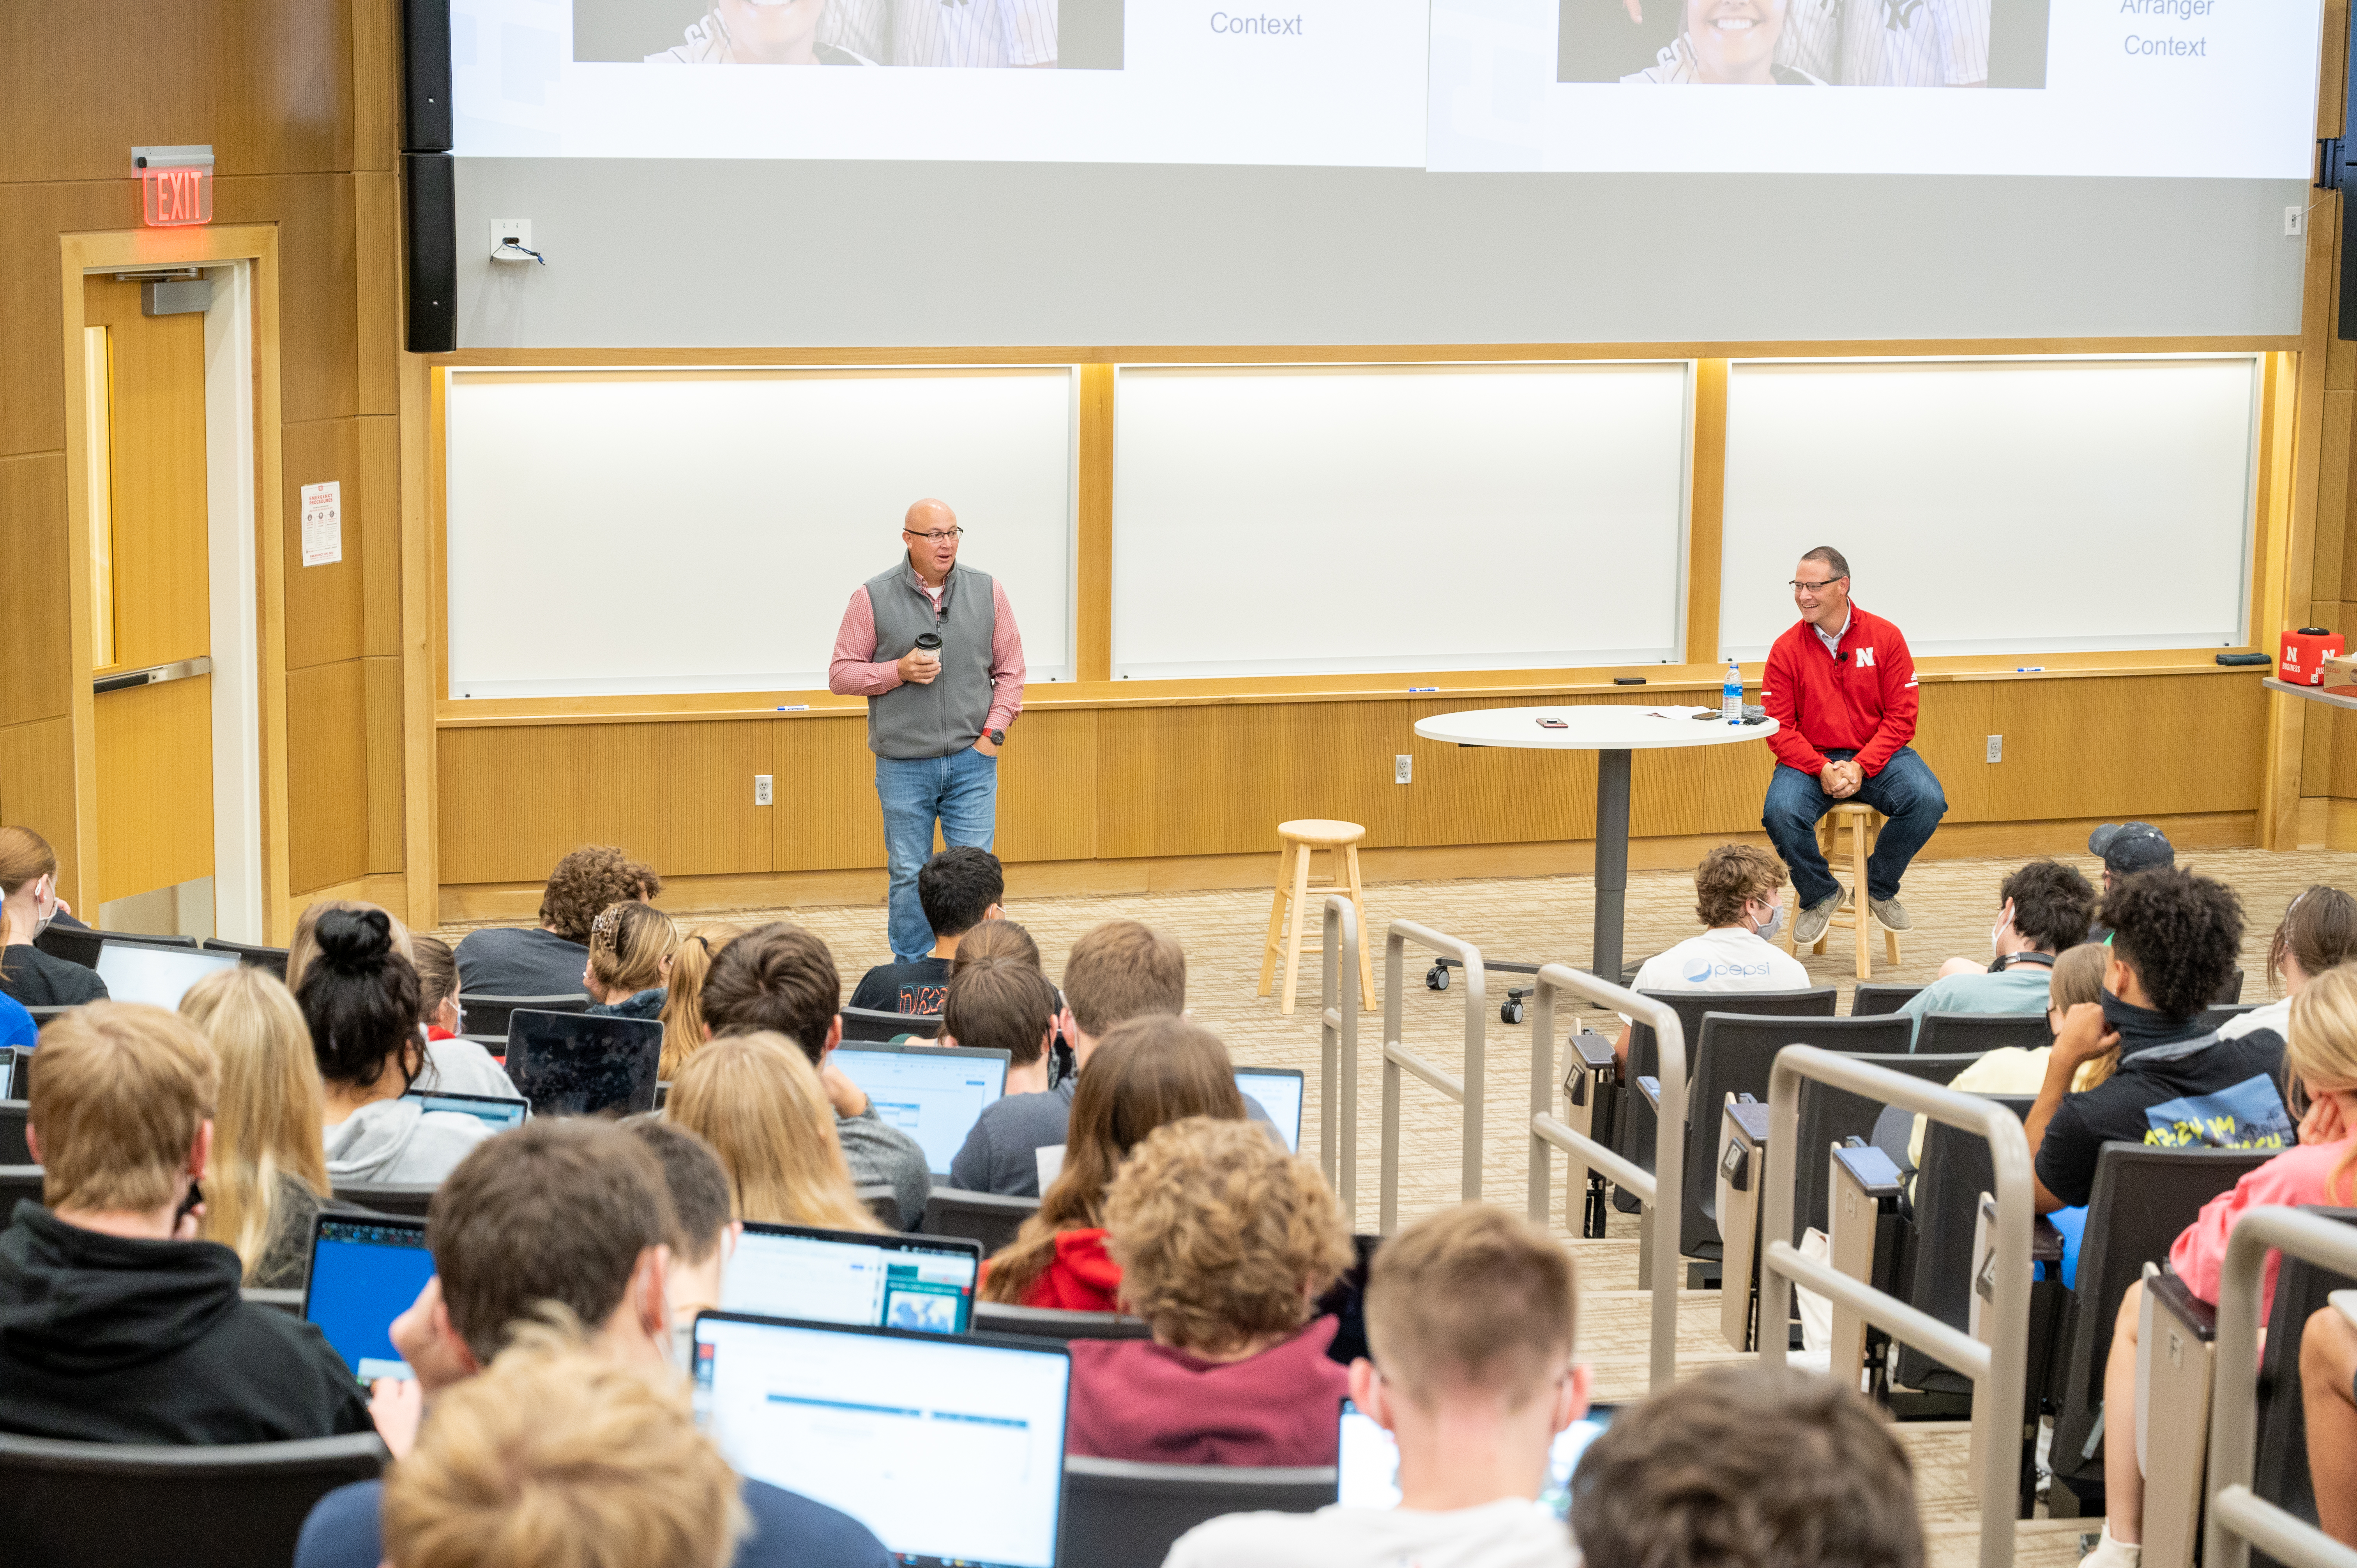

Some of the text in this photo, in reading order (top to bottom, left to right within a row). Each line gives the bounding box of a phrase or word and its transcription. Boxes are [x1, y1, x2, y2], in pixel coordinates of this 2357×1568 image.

[2120, 0, 2215, 20] Arranger
[1211, 11, 1303, 35] Context
[2124, 34, 2207, 57] Context
[157, 171, 203, 221] EXIT
[1856, 646, 1876, 667] N
[2286, 646, 2298, 662] N
[2321, 649, 2335, 665] N
[2282, 662, 2300, 673] BUSINESS
[1715, 962, 1770, 978] pepsi
[2169, 1334, 2179, 1358] F
